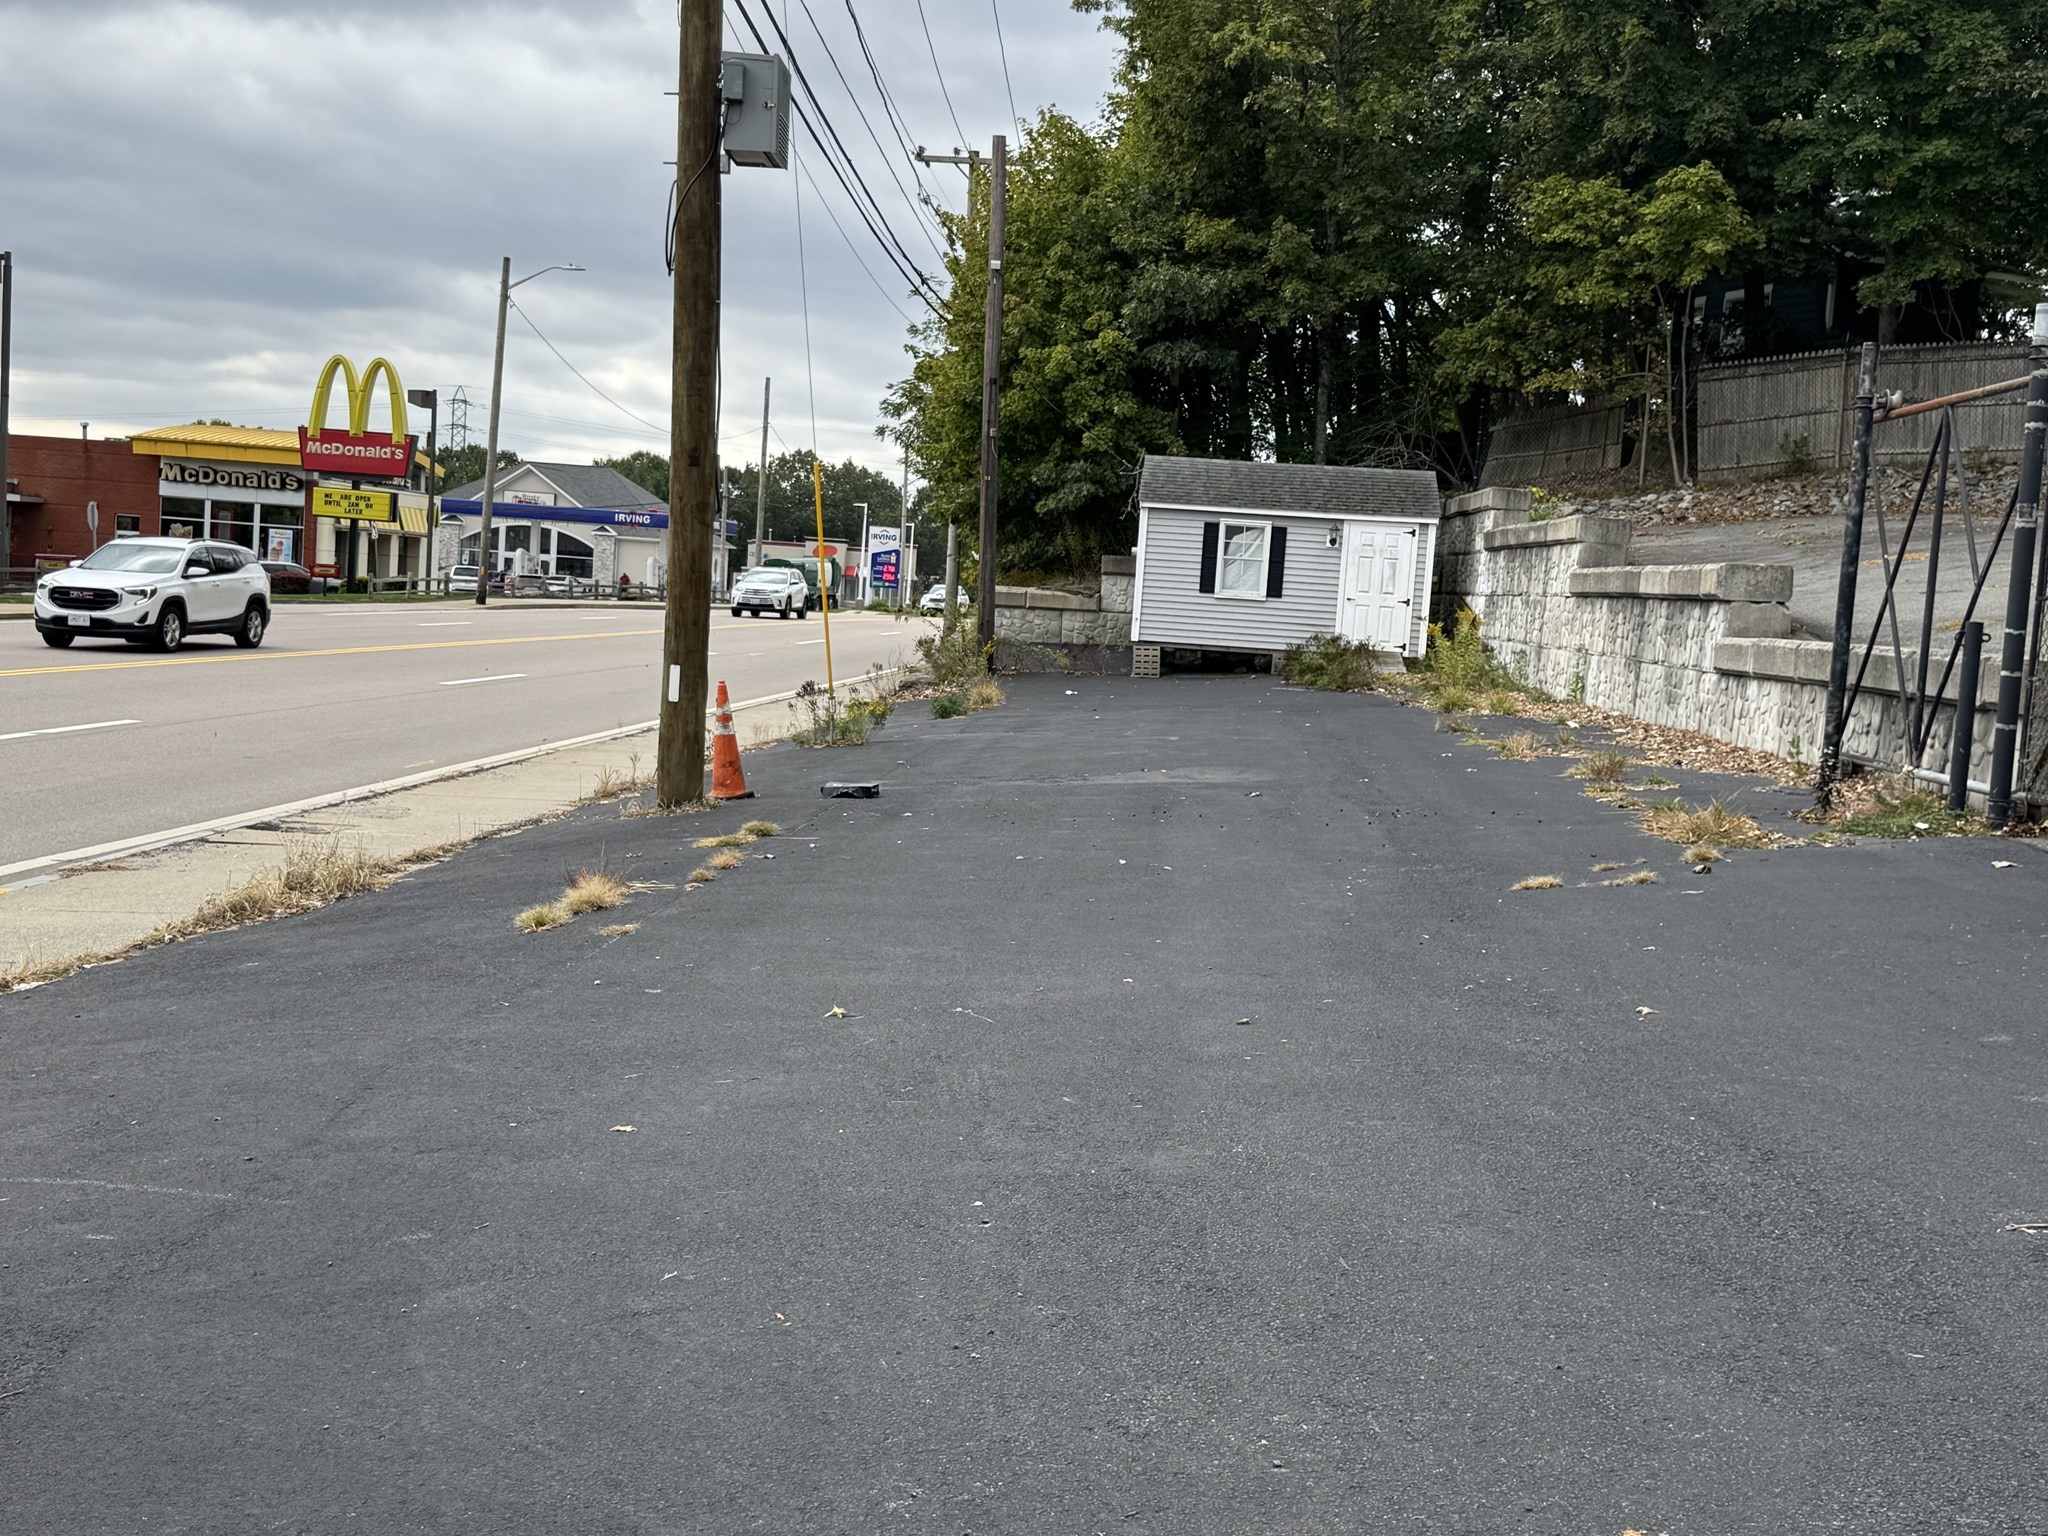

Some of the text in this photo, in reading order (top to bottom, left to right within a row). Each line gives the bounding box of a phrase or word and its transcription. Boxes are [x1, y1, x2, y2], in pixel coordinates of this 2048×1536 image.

[306, 440, 404, 460] McDonald's
[160, 462, 301, 492] McDonald's
[355, 495, 371, 503] OPEN
[344, 507, 363, 515] LATER
[614, 513, 651, 524] IRVING
[871, 533, 897, 541] IRVING
